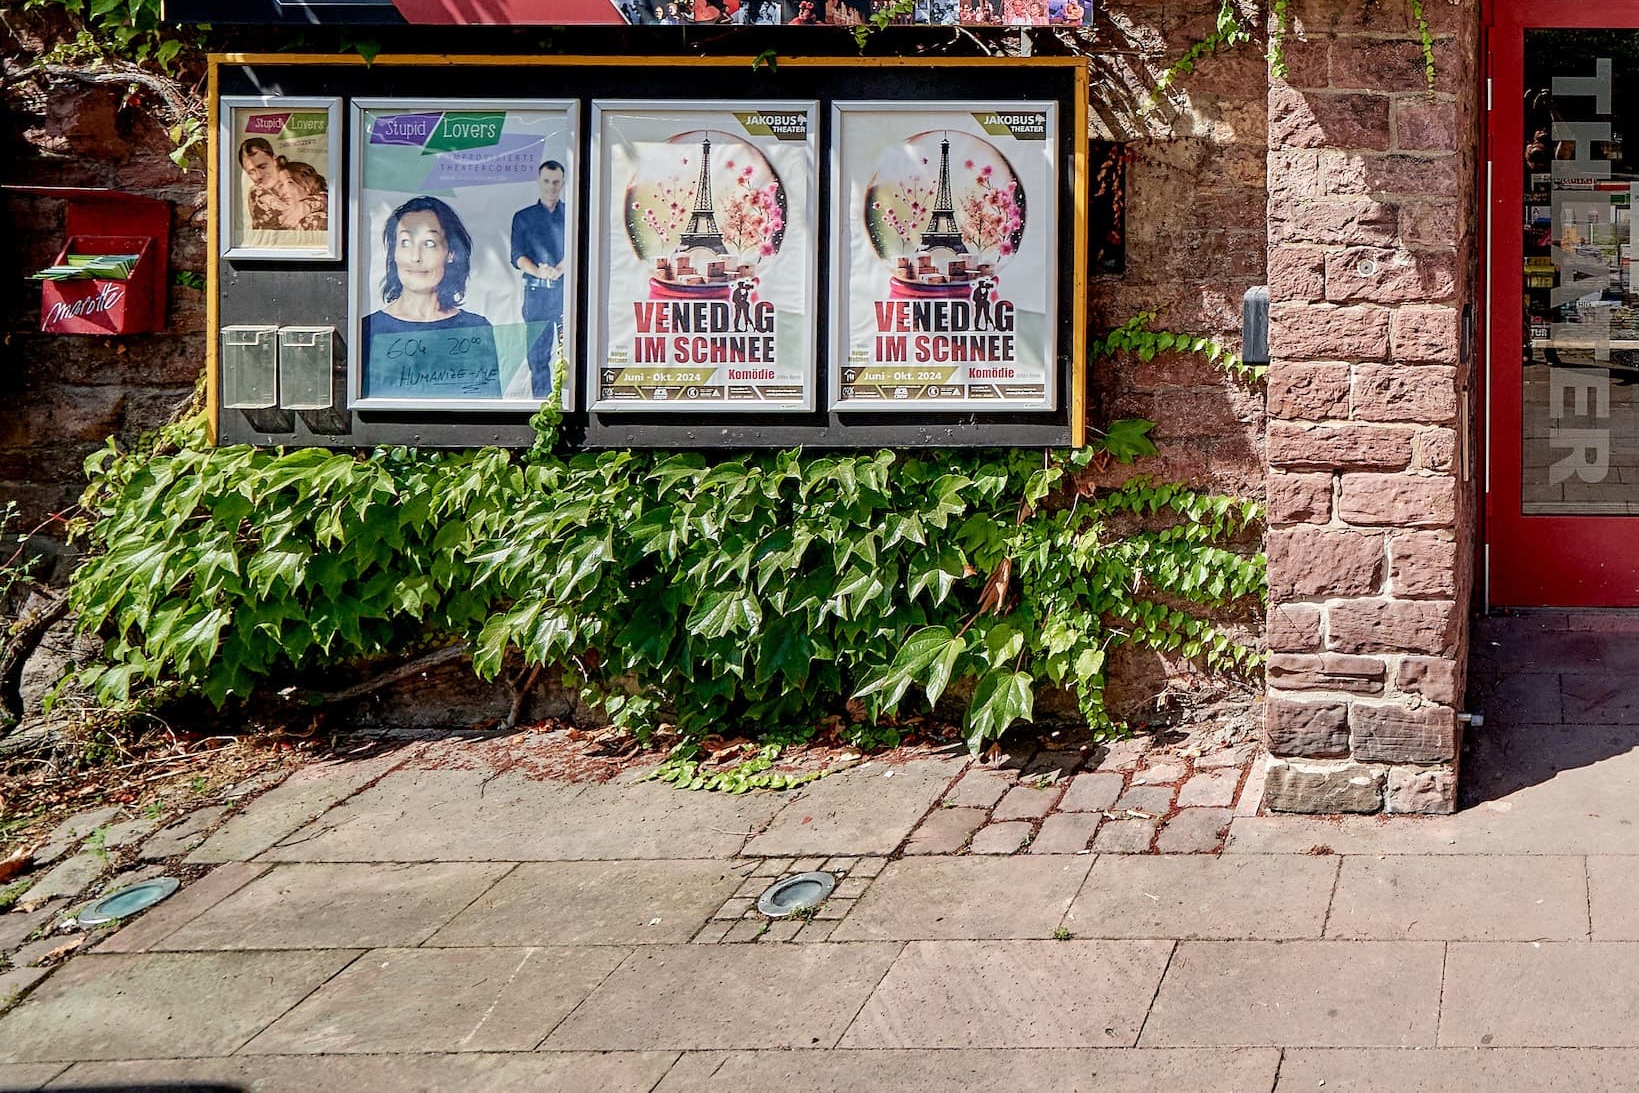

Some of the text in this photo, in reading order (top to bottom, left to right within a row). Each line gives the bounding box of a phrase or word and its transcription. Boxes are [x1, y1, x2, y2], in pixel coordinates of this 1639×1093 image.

[255, 117, 325, 131] Stupid Lovers
[746, 115, 797, 125] JAKOBUS
[984, 115, 1035, 125] JAKOBUS
[385, 119, 496, 140] Stupid Lovers
[1549, 58, 1612, 484] THEATER
[42, 282, 125, 332] marotte
[634, 337, 666, 363] IM
[674, 336, 775, 363] SCHNEE
[875, 335, 907, 362] IM
[915, 335, 1014, 362] SCHNEE
[623, 373, 644, 382] Juni
[653, 372, 673, 382] Okt.
[677, 372, 701, 382] 2024
[729, 368, 775, 380] Komödie
[863, 372, 885, 381] Juni
[894, 371, 914, 381] Okt.
[917, 371, 942, 381] 2024
[969, 367, 1015, 379] Komödie
